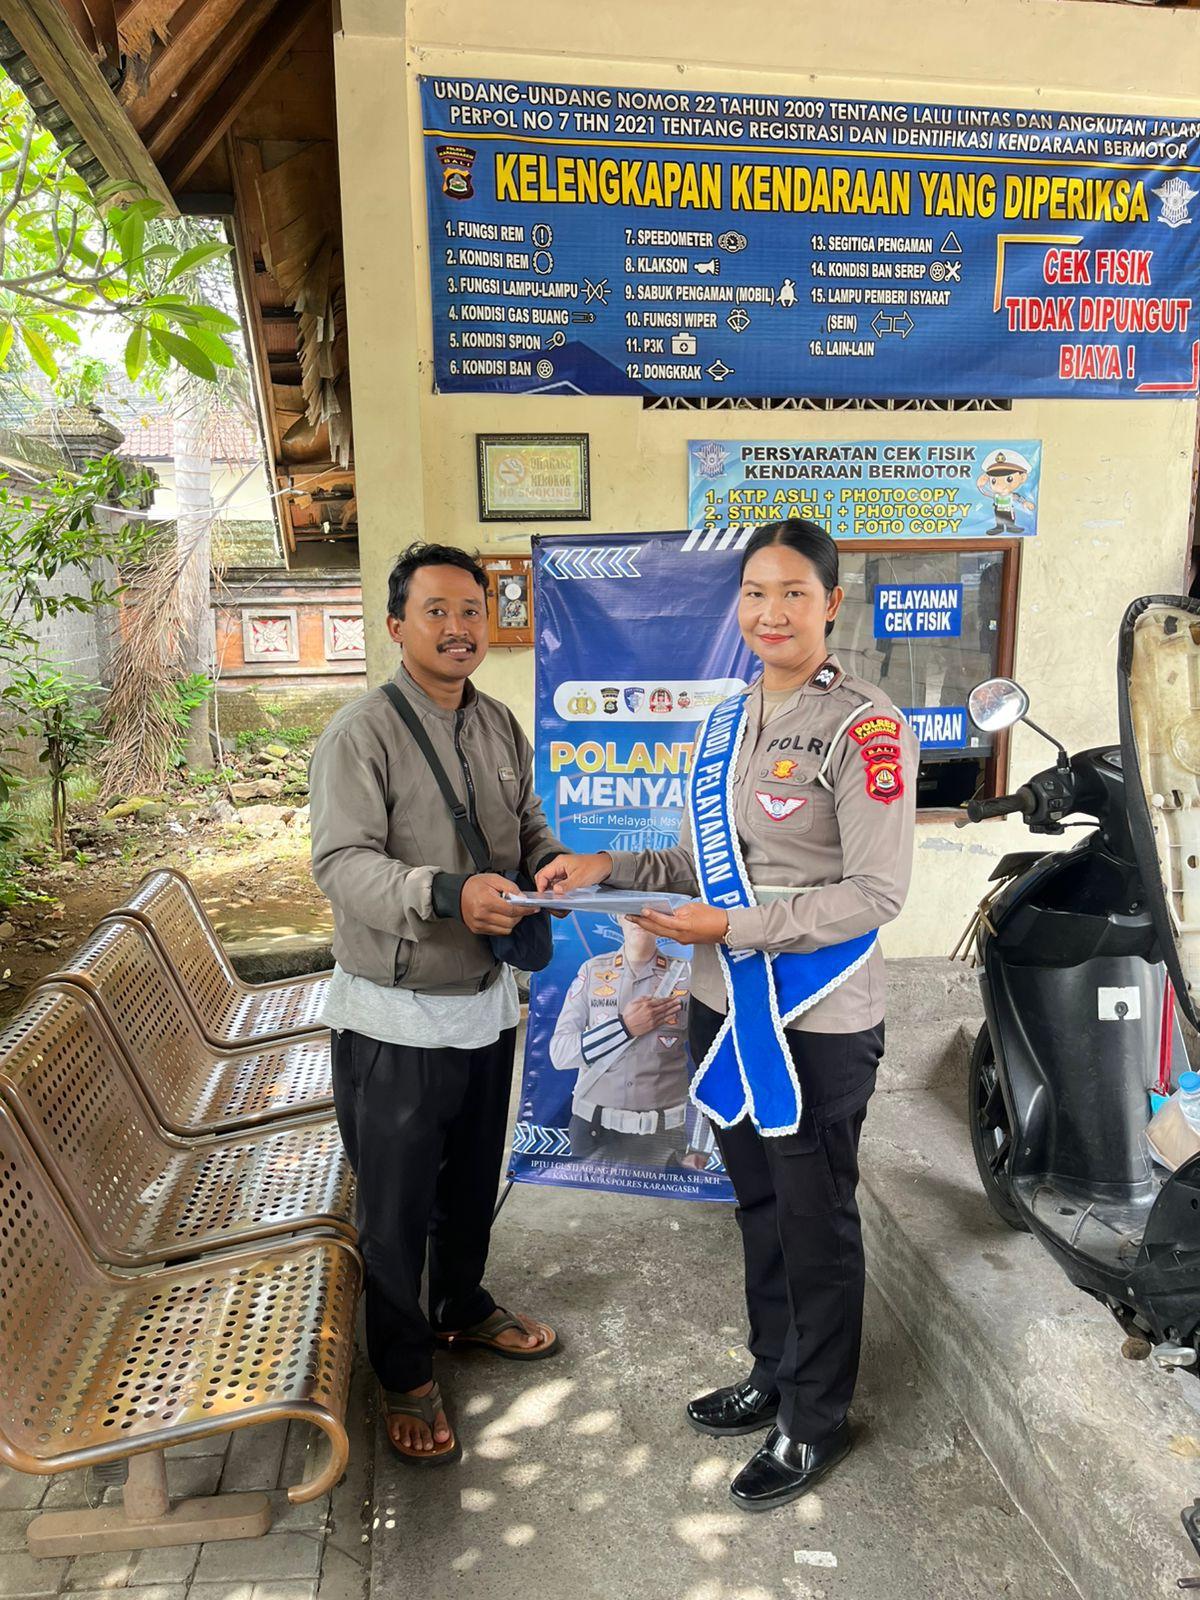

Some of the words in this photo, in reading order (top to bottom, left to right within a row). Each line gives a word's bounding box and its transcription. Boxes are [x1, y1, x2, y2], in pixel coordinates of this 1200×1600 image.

[434, 81, 612, 108] UNDANG-UNDANG
[618, 92, 690, 113] NOMOR
[695, 96, 716, 114] 22
[720, 98, 779, 117] TAHUN
[784, 101, 825, 120] 2009
[829, 102, 907, 123] TENTANG
[913, 108, 952, 126] LALU
[957, 109, 1010, 128] LINTAS
[1016, 112, 1052, 130] DAN
[1057, 114, 1147, 136] ANGKUTAN
[1150, 121, 1200, 138] JALAN
[451, 106, 518, 129] PERPOL
[523, 110, 552, 131] NO
[558, 112, 569, 131] 7
[574, 113, 610, 133] THN
[614, 115, 655, 134] 2021
[661, 117, 744, 139] TENTANG
[749, 120, 844, 142] REGISTRASI
[849, 127, 888, 144] DAN
[892, 129, 992, 149] IDENTIFIKASI
[998, 133, 1099, 155] KENDARAAN
[1104, 138, 1188, 159] BERMOTOR
[495, 152, 722, 210] KELENGKAPAN
[731, 164, 910, 215] KENDARAAN
[920, 171, 997, 218] YANG
[1003, 174, 1149, 222] DIPERIKSA
[445, 223, 456, 237] 1.
[458, 225, 498, 241] FUNGSI
[501, 227, 524, 242] REM
[625, 229, 635, 245] 7.
[637, 230, 713, 248] SPEEDOMETER
[811, 236, 826, 251] 13.
[828, 236, 875, 252] SEGITIGA
[877, 237, 933, 253] PENGAMAN
[446, 250, 457, 265] 2.
[459, 251, 503, 269] KONDISI
[506, 253, 529, 270] REM
[625, 258, 635, 273] 8.
[637, 258, 688, 274] KLAKSON
[1043, 248, 1089, 285] CEK
[1094, 249, 1153, 285] FISIK
[811, 263, 826, 277] 14.
[828, 263, 869, 278] KONDISI
[872, 263, 892, 278] BAN
[894, 264, 926, 279] SEREP
[448, 278, 458, 293] 3.
[460, 278, 500, 295] FUNGSI
[503, 281, 578, 299] LAMPU-LAMPU
[625, 286, 635, 301] 9.
[637, 286, 673, 301] SABUK
[675, 286, 733, 303] PENGAMAN
[735, 286, 775, 306] (MOBIL)
[811, 289, 826, 303] 15.
[828, 289, 862, 304] LAMPU
[864, 290, 907, 304] PEMBERI
[909, 290, 951, 306] ISYARAT
[448, 306, 459, 320] 4.
[461, 306, 505, 322] KONDISI
[507, 309, 530, 323] GAS
[532, 310, 569, 325] BUANG
[626, 312, 641, 327] 10.
[643, 312, 682, 328] FUNGSI
[684, 313, 717, 329] WIPER
[827, 314, 858, 333] (SEIN)
[1005, 297, 1075, 332] TIDAK
[1078, 297, 1192, 333] DIPUNGUT
[449, 333, 460, 348] 5.
[461, 333, 506, 349] KONDISI
[508, 334, 541, 350] SPION
[626, 338, 641, 353] 11.
[644, 338, 664, 354] P3K
[809, 341, 824, 356] 16.
[826, 341, 875, 357] LAIN-LAIN
[450, 361, 460, 375] 6.
[462, 360, 507, 376] KONDISI
[509, 361, 532, 376] BAN
[1059, 345, 1122, 380] BIAYA
[627, 364, 642, 379] 12.
[644, 364, 702, 381] DONGKRAK
[741, 446, 878, 462] PERSYARATAN
[883, 446, 924, 461] CEK
[927, 446, 976, 461] FISIK
[744, 465, 866, 480] KENDARAAN
[869, 464, 971, 479] BERMOTOR
[519, 486, 571, 497] SMOKING
[705, 489, 723, 504] 1.
[728, 489, 767, 503] KTP
[773, 489, 818, 503] ASLI
[824, 490, 835, 502] +
[840, 488, 959, 503] PHOTOCOPY
[704, 506, 722, 520] 2.
[728, 505, 783, 519] STNK
[787, 505, 832, 519] ASLI
[837, 506, 849, 517] +
[855, 503, 972, 519] PHOTOCOPY
[837, 521, 849, 533] +
[854, 519, 905, 535] FOTO
[909, 519, 962, 534] COPY
[879, 589, 958, 610] PELAYANAN
[885, 613, 912, 632] CEK
[916, 611, 951, 631] FISIK
[702, 695, 740, 759] MANDU
[902, 713, 962, 742] FTARAN
[550, 741, 693, 774] POLANT
[868, 747, 893, 755] BALI
[560, 775, 684, 807] MENYA
[573, 813, 602, 825] Hadir
[608, 815, 656, 828] Melayani
[661, 817, 682, 828] Masy
[697, 761, 732, 884] PELAYANAN
[633, 1170, 657, 1180] MAHA
[611, 1178, 641, 1188] POLRES
[643, 1181, 699, 1194] KARANGASEM
